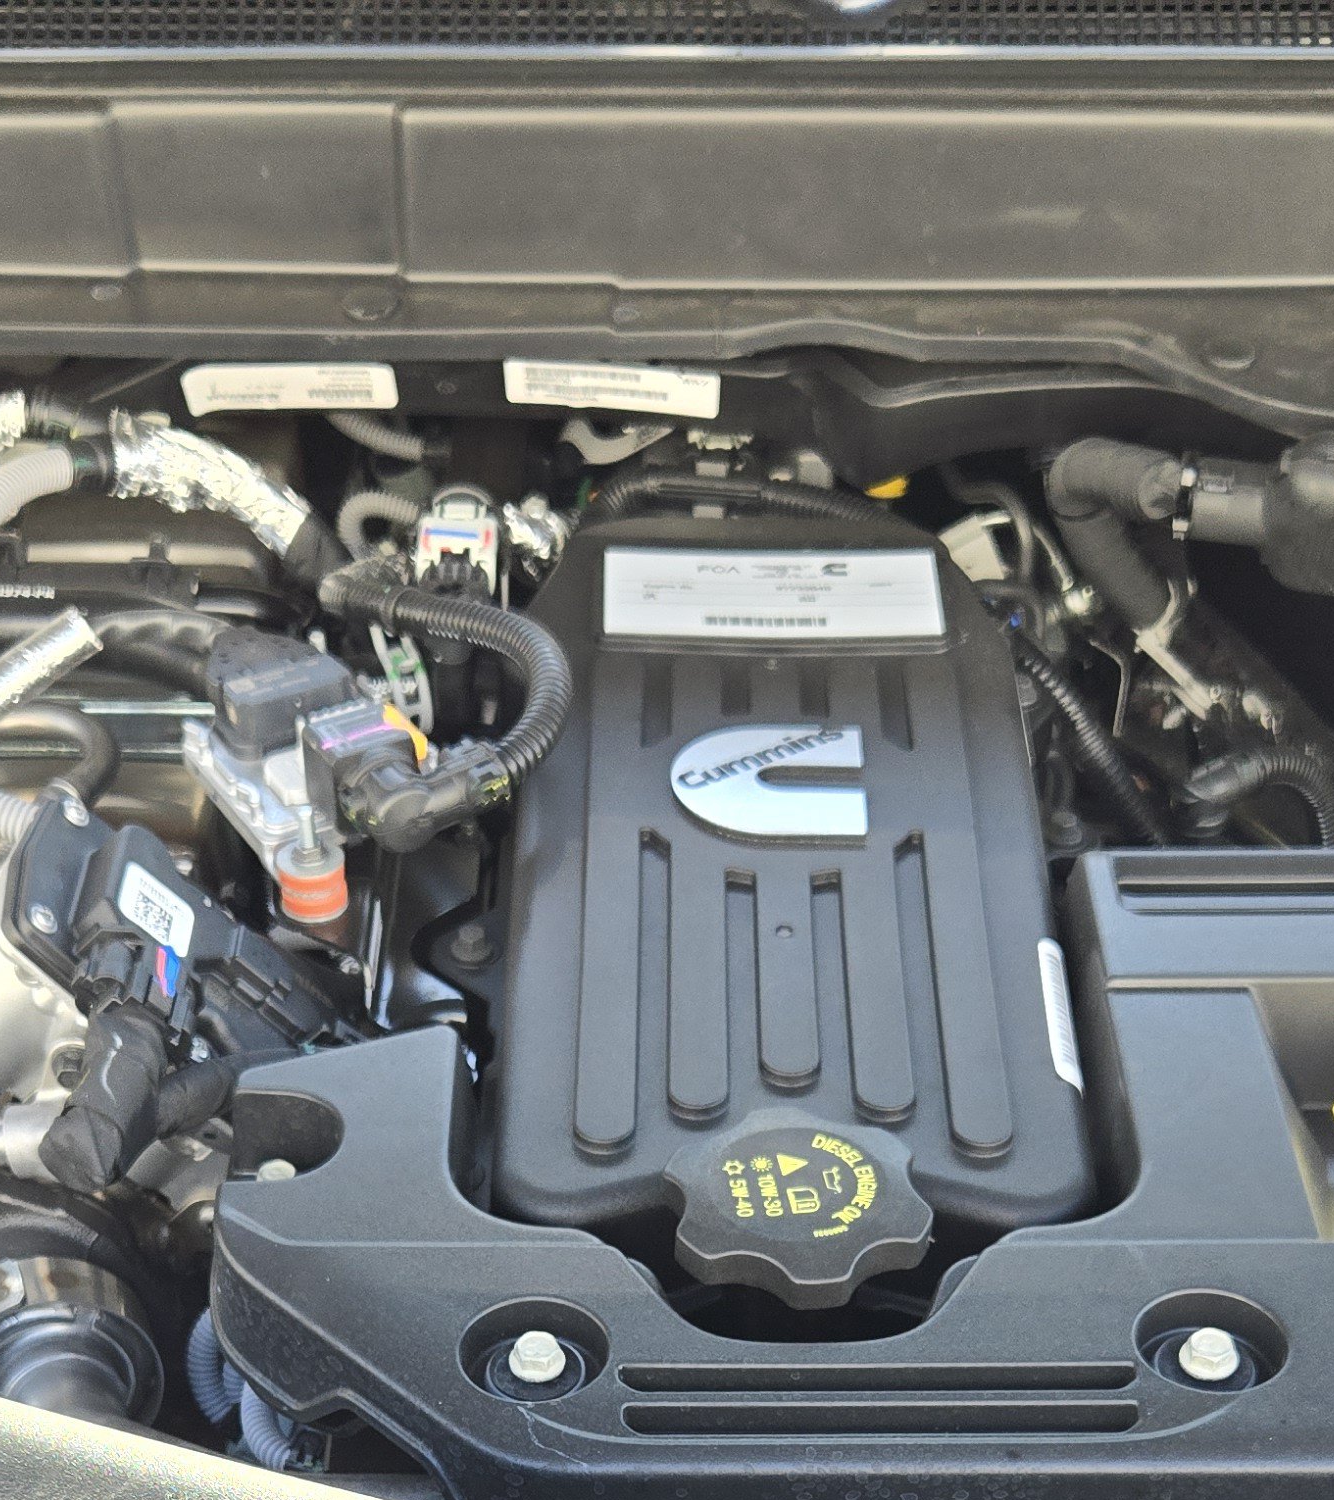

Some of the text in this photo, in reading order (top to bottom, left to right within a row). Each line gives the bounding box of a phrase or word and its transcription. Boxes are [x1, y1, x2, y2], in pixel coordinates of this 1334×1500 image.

[677, 730, 845, 790] Cummins
[811, 1132, 864, 1169] DIESEL
[728, 1176, 756, 1219] 5W-40
[756, 1172, 785, 1218] 10W-30
[851, 1163, 879, 1211] ENGINE
[830, 1204, 863, 1225] OIL
